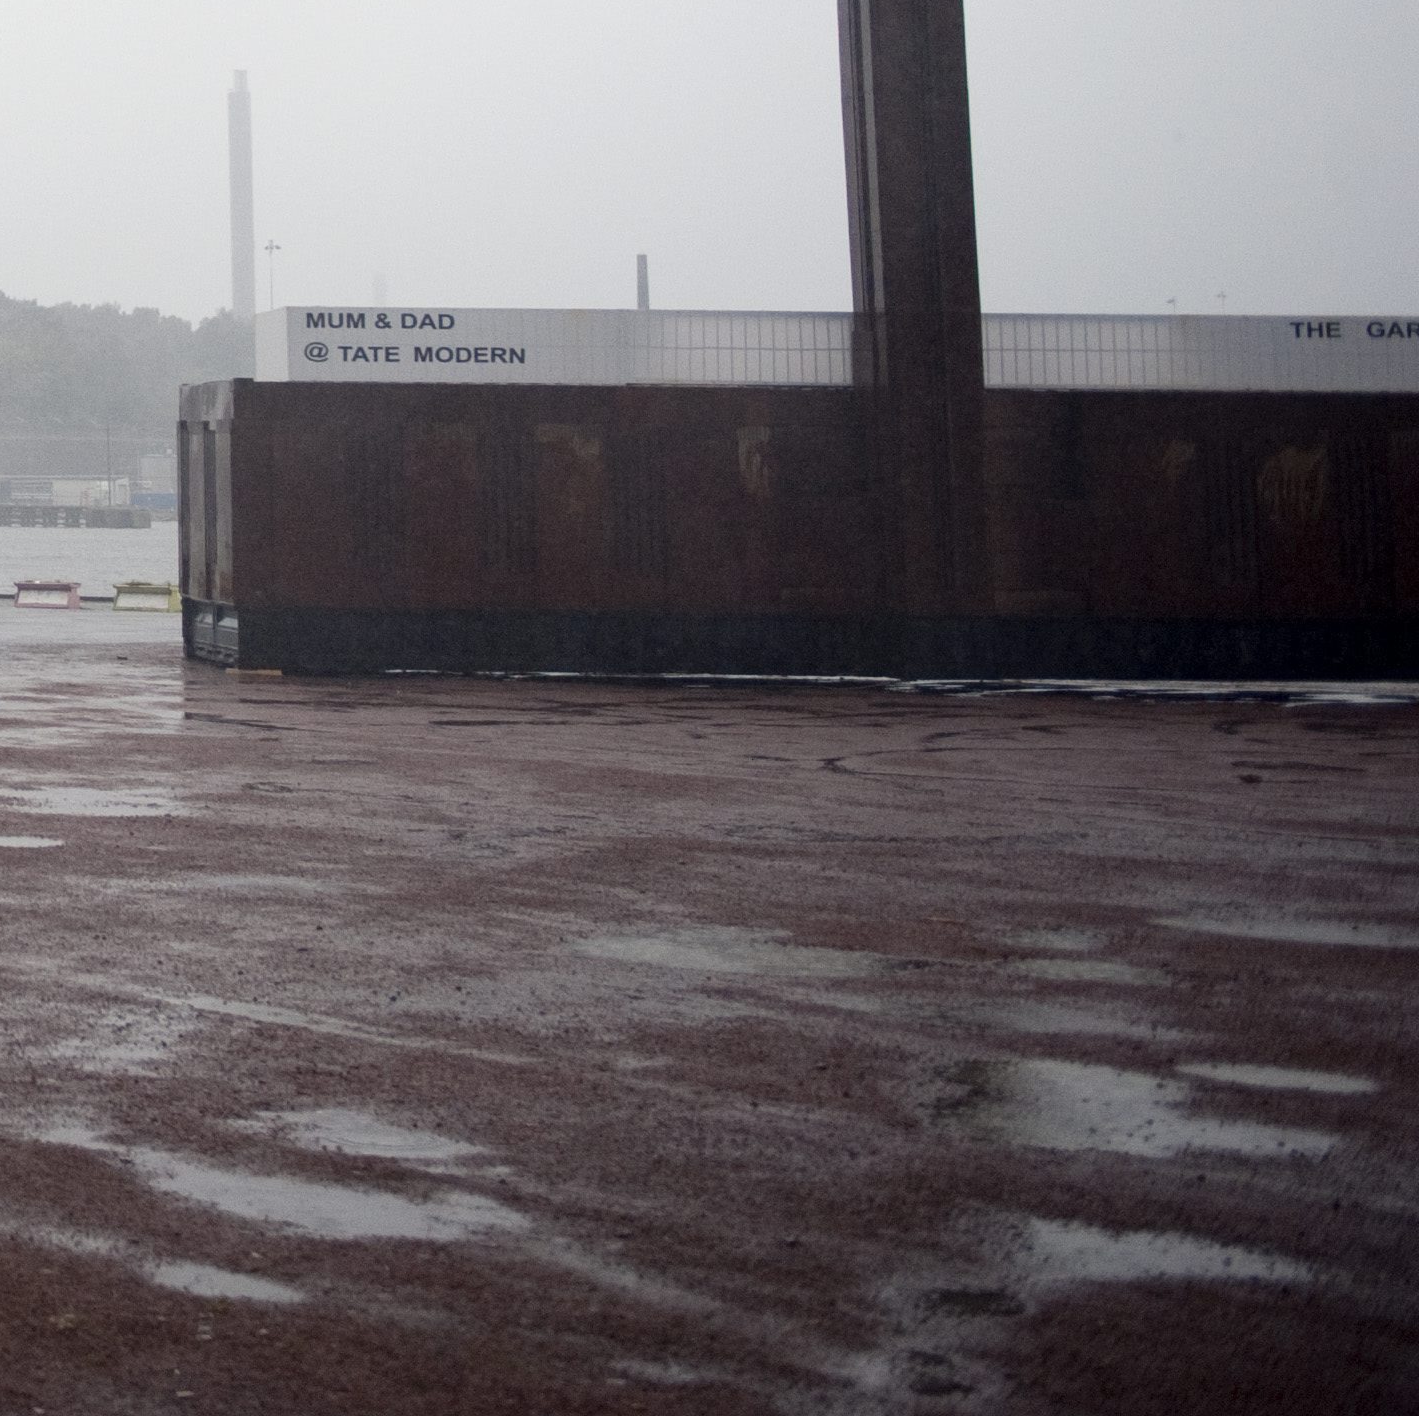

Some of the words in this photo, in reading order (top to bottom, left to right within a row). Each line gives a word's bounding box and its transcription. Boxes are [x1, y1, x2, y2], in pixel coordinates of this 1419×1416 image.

[305, 312, 366, 329] MUM
[374, 312, 392, 329] &
[400, 312, 455, 330] DAD
[1289, 321, 1342, 338] THE
[303, 341, 330, 362] @
[337, 346, 401, 362] TATE
[413, 346, 526, 364] MODERN
